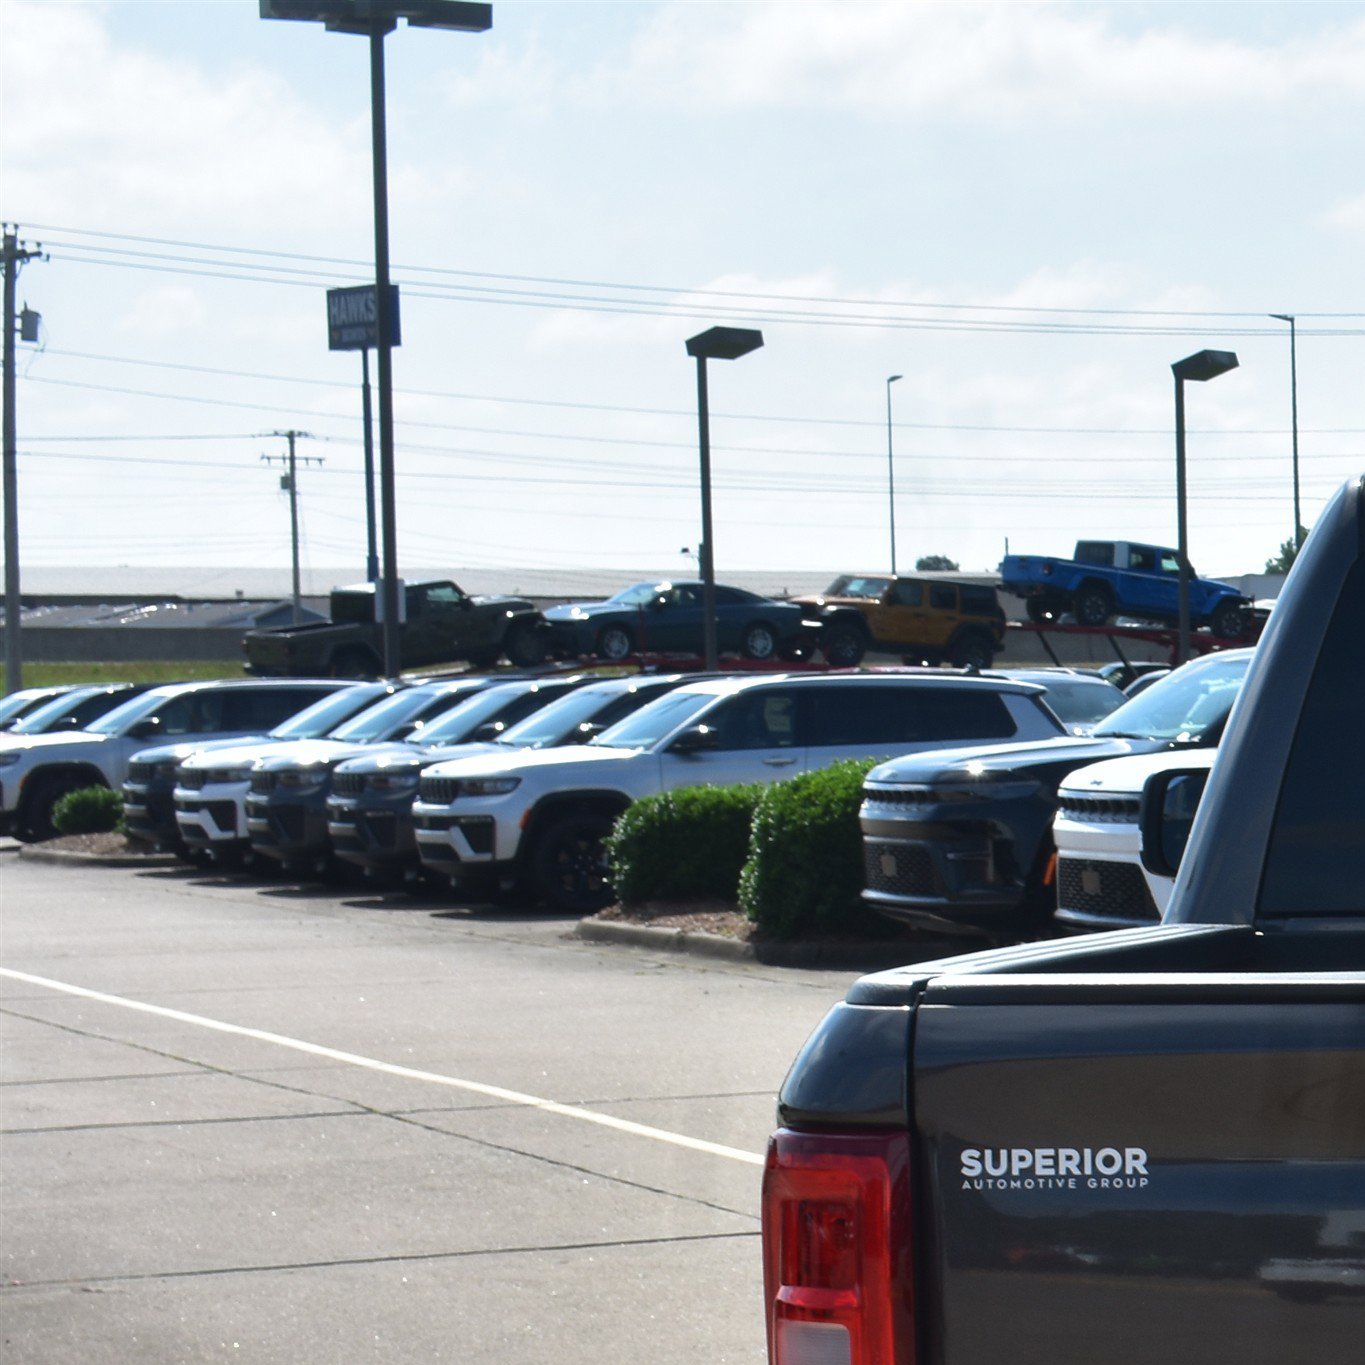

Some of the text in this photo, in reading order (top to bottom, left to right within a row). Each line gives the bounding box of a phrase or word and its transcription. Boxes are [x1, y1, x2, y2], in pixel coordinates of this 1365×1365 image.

[960, 1147, 1148, 1176] SUPERIOR
[961, 1177, 1148, 1190] AUTOMOTIVE GROUP
